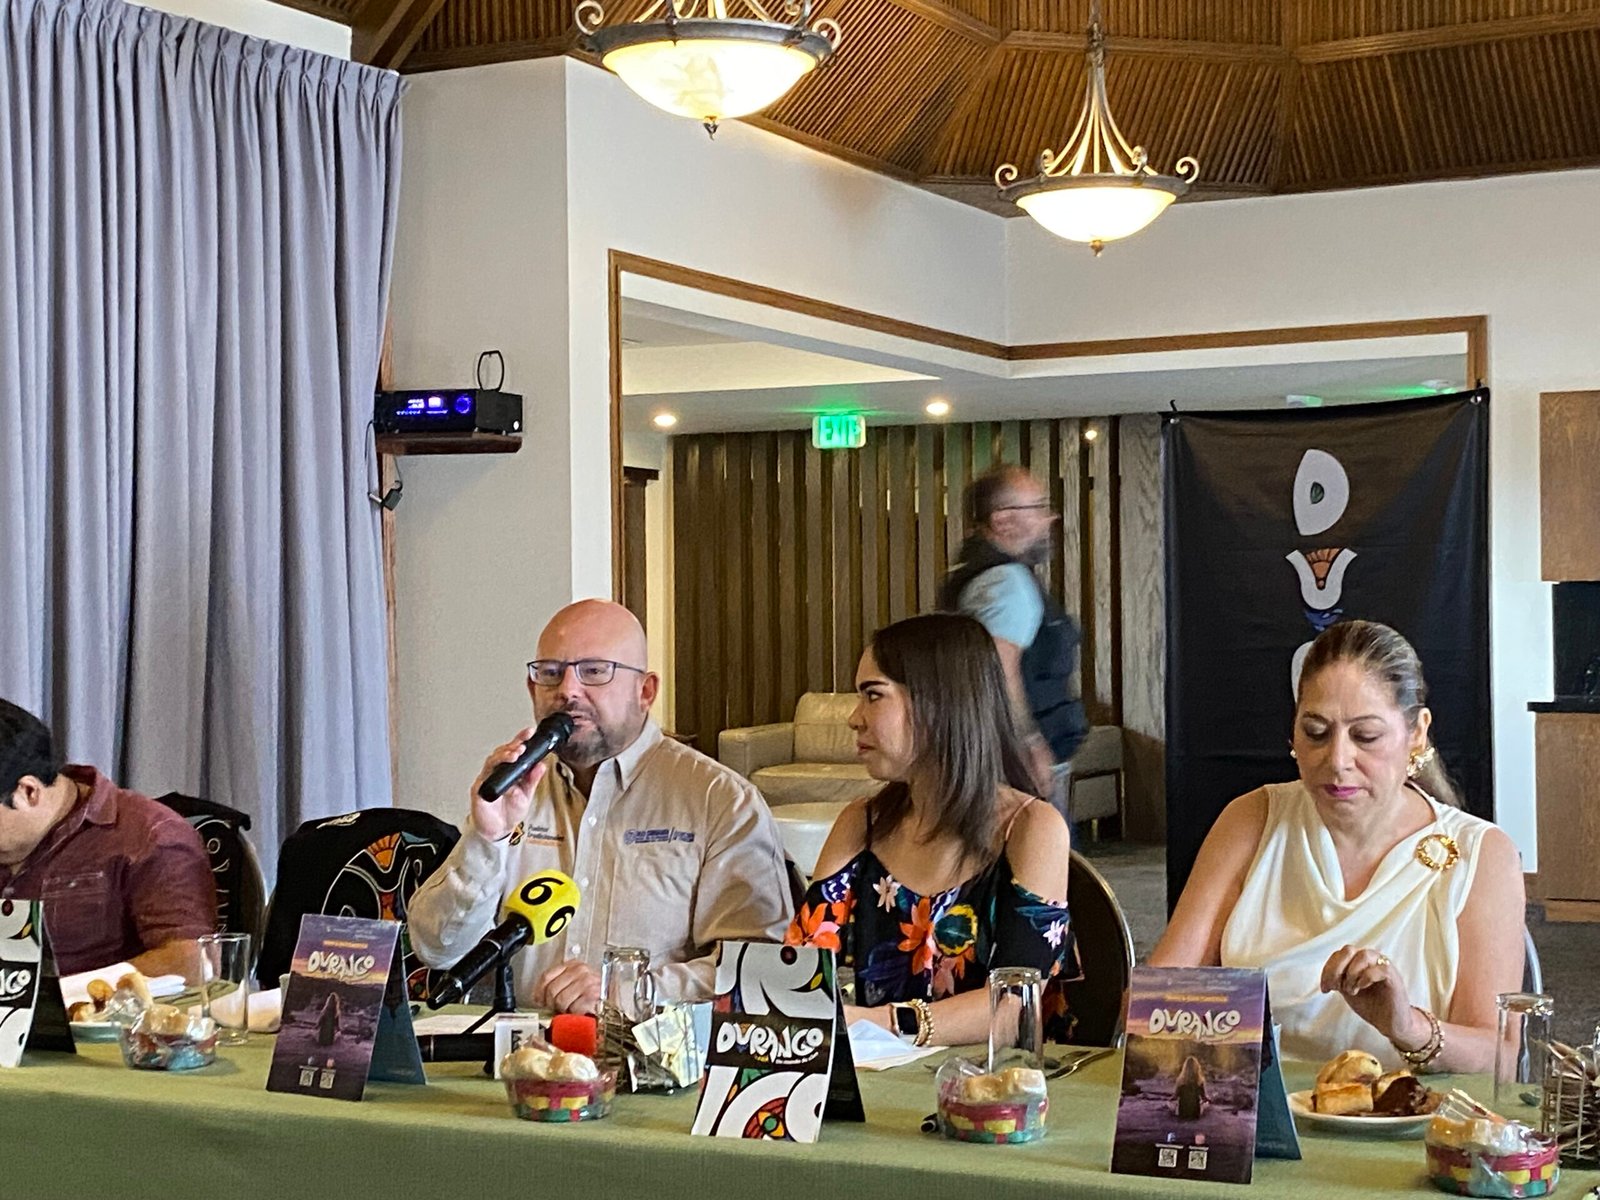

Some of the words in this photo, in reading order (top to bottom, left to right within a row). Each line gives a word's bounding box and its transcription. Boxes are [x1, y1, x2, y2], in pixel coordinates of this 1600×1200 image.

[520, 877, 564, 905] 6
[545, 905, 576, 938] 6
[307, 951, 375, 980] DURANGO
[1150, 1008, 1241, 1040] DURANGO
[716, 1022, 824, 1063] DURANGO
